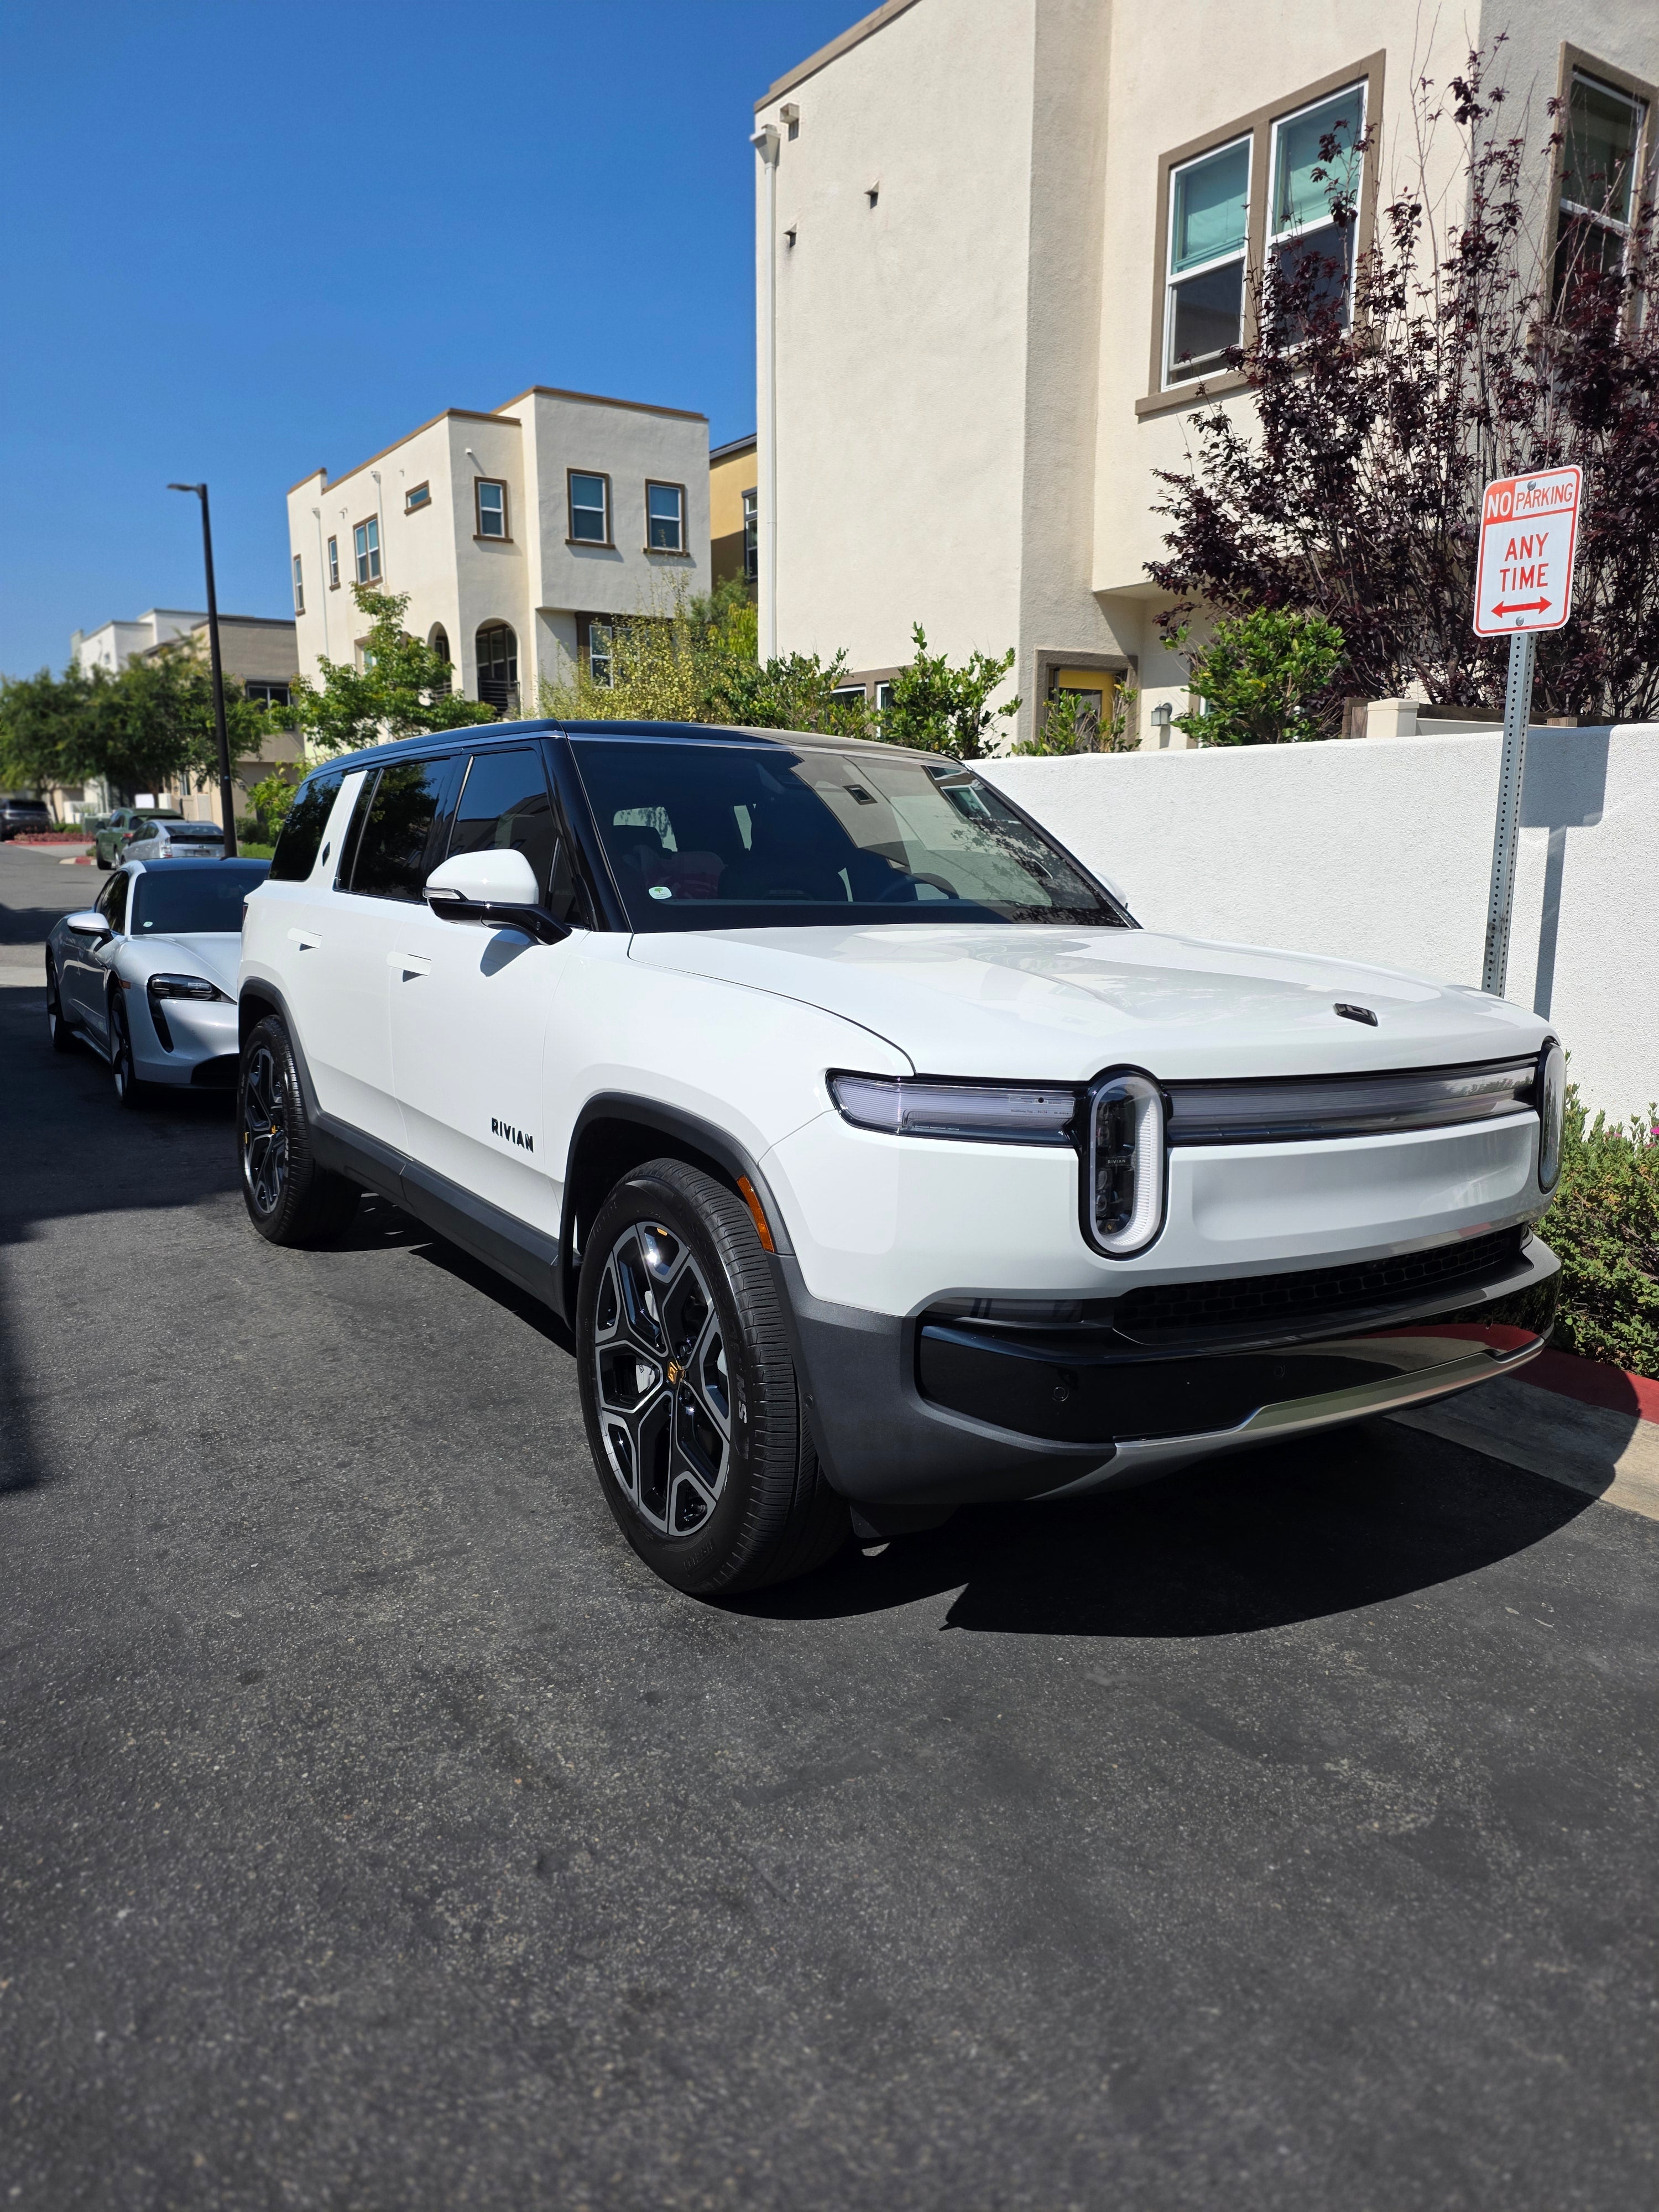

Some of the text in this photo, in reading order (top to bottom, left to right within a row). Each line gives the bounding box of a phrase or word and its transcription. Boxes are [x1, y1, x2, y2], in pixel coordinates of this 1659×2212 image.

[1486, 483, 1573, 519] NO PARKING
[1504, 532, 1549, 562] ANY
[1500, 563, 1549, 592] TIME
[491, 1117, 534, 1153] RIVIAN
